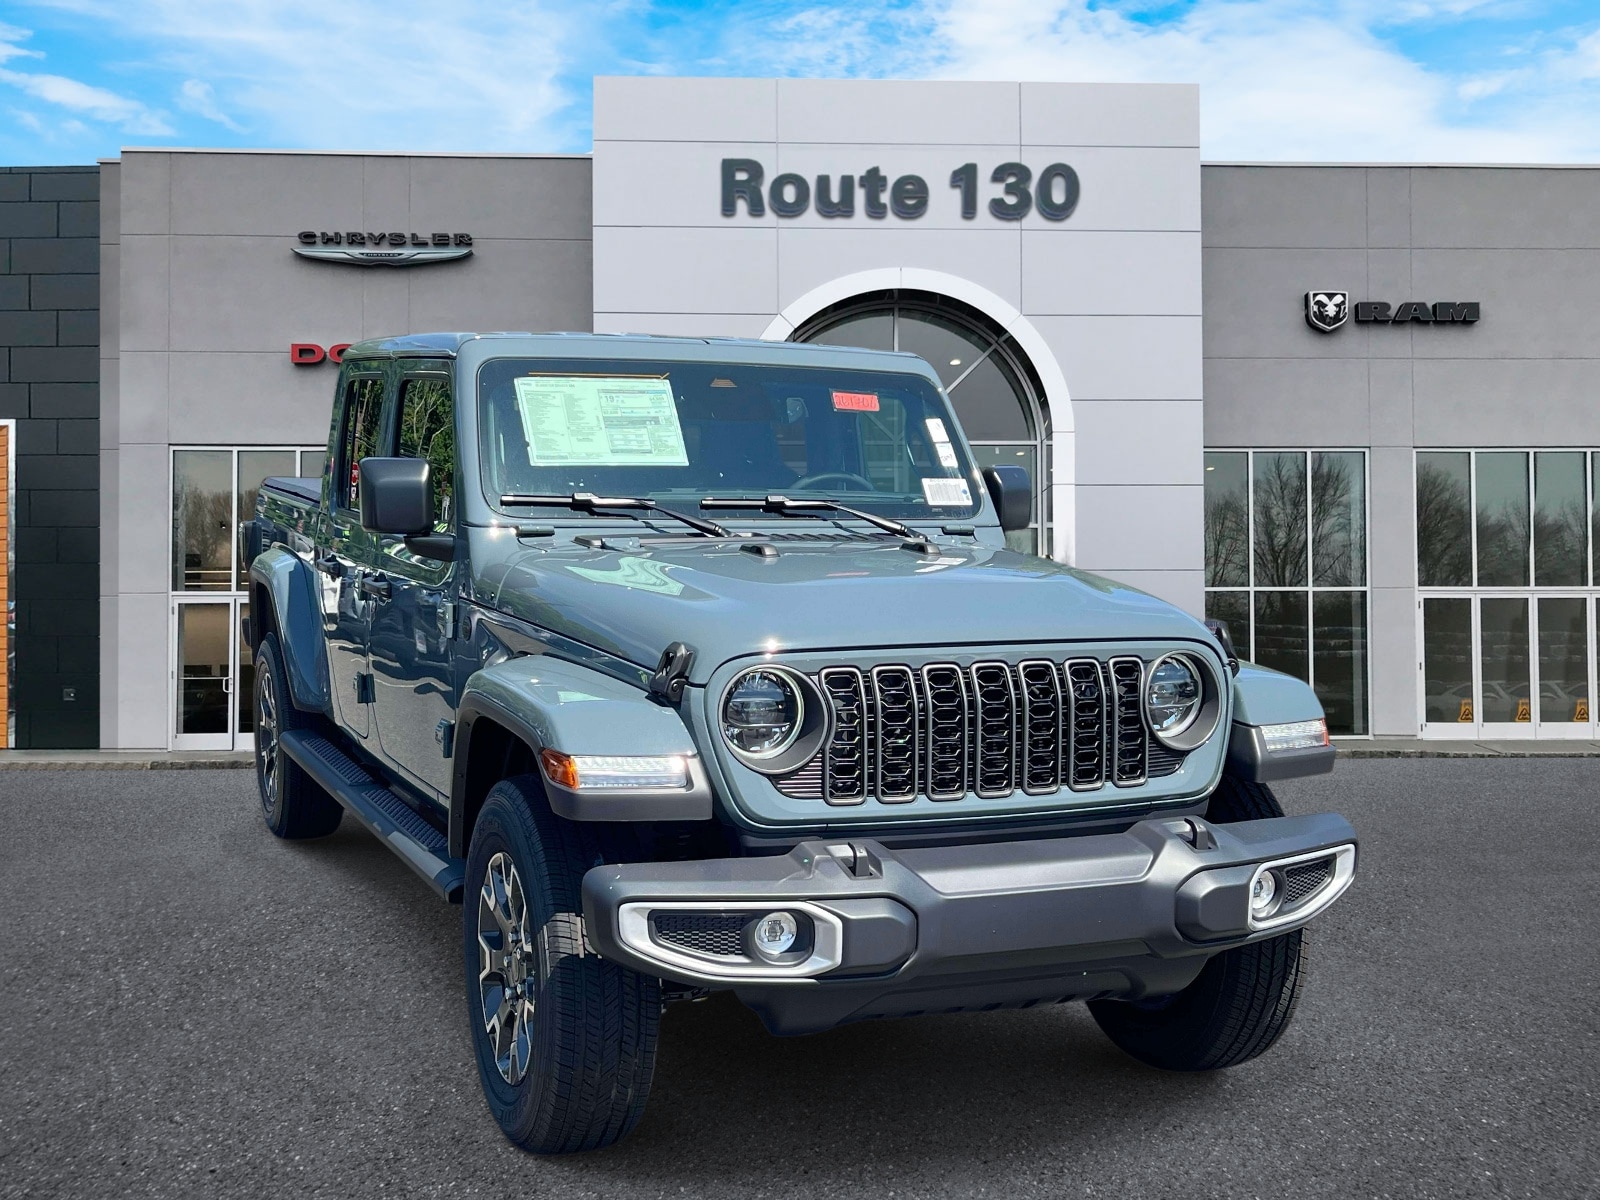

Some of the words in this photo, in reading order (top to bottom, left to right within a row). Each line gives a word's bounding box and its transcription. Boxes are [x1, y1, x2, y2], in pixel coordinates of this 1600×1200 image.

[721, 158, 929, 218] Route
[950, 162, 1080, 221] 130
[298, 231, 473, 246] CHRYSLER
[1355, 302, 1480, 324] RAM
